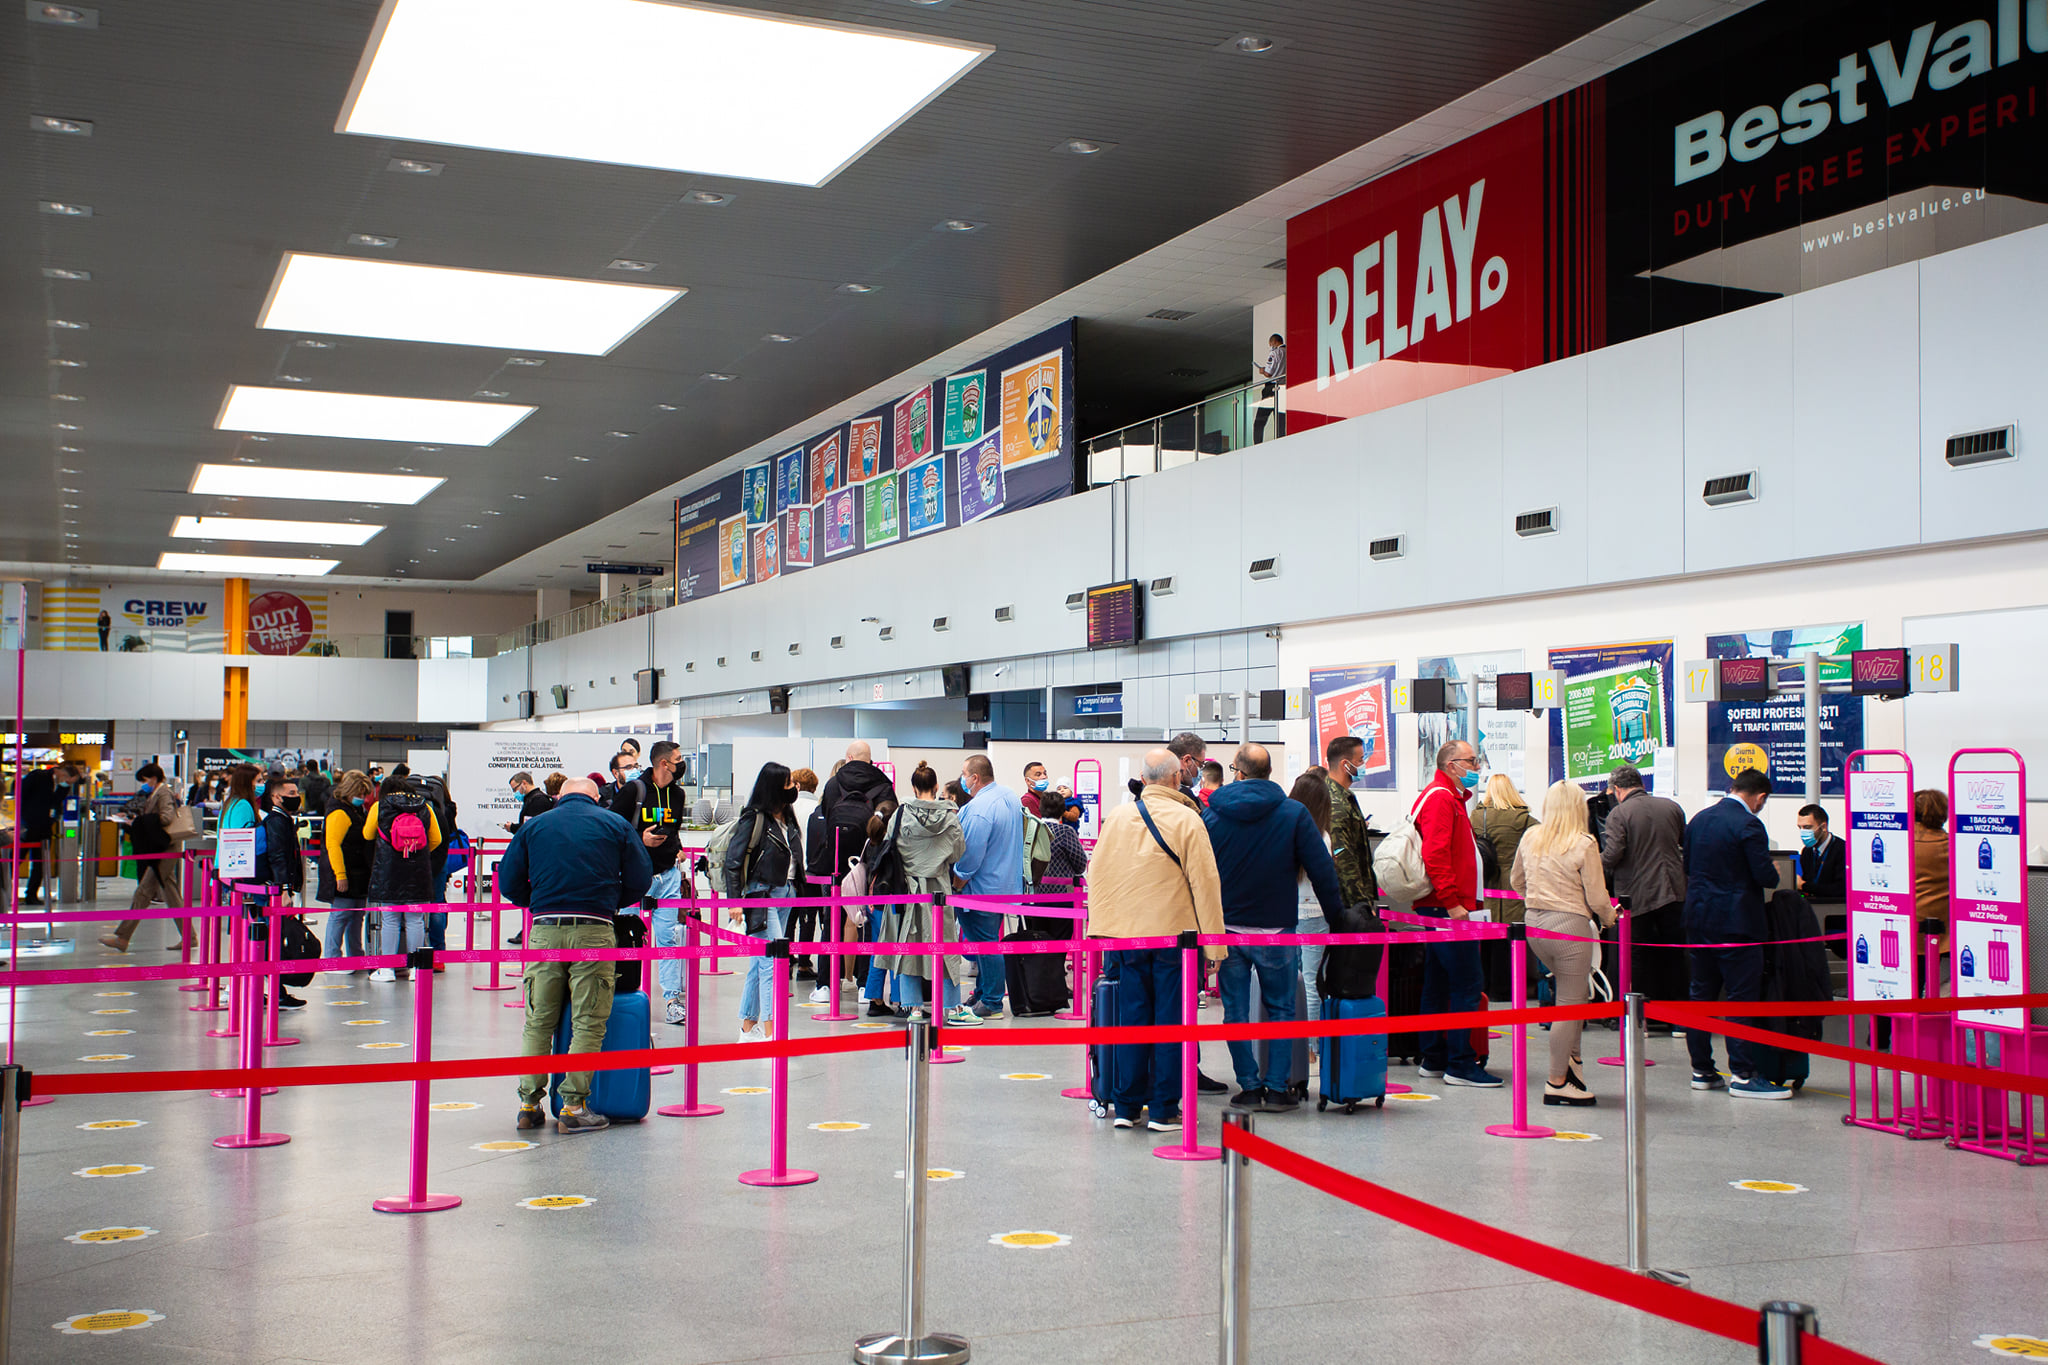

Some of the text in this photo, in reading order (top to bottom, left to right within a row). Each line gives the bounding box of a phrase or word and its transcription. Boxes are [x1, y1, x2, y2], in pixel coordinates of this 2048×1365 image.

[1674, 186, 1756, 236] DUTY
[1775, 147, 1864, 204] FREE
[1803, 188, 1986, 254] www.bestvalue.eu
[124, 599, 207, 616] CREW
[147, 616, 184, 627] SHOP
[251, 606, 298, 630] DUTY
[258, 623, 303, 646] FREE
[1916, 654, 1944, 682] 18
[1687, 668, 1710, 693] 17
[1393, 686, 1408, 706] 15
[1536, 678, 1553, 700] 16
[1187, 701, 1197, 717] 13
[1287, 695, 1299, 712] 14
[1732, 723, 1742, 732] PE
[1743, 723, 1769, 732] TRAFIC
[1883, 821, 1902, 830] Priority
[1973, 816, 1987, 824] BAG
[1991, 825, 2013, 834] Priority
[1864, 902, 1898, 912] WIZZ Priority
[1874, 895, 1889, 903] BAGS
[1981, 904, 1998, 912] BAGS
[1969, 911, 2008, 922] WIZZ Priority
